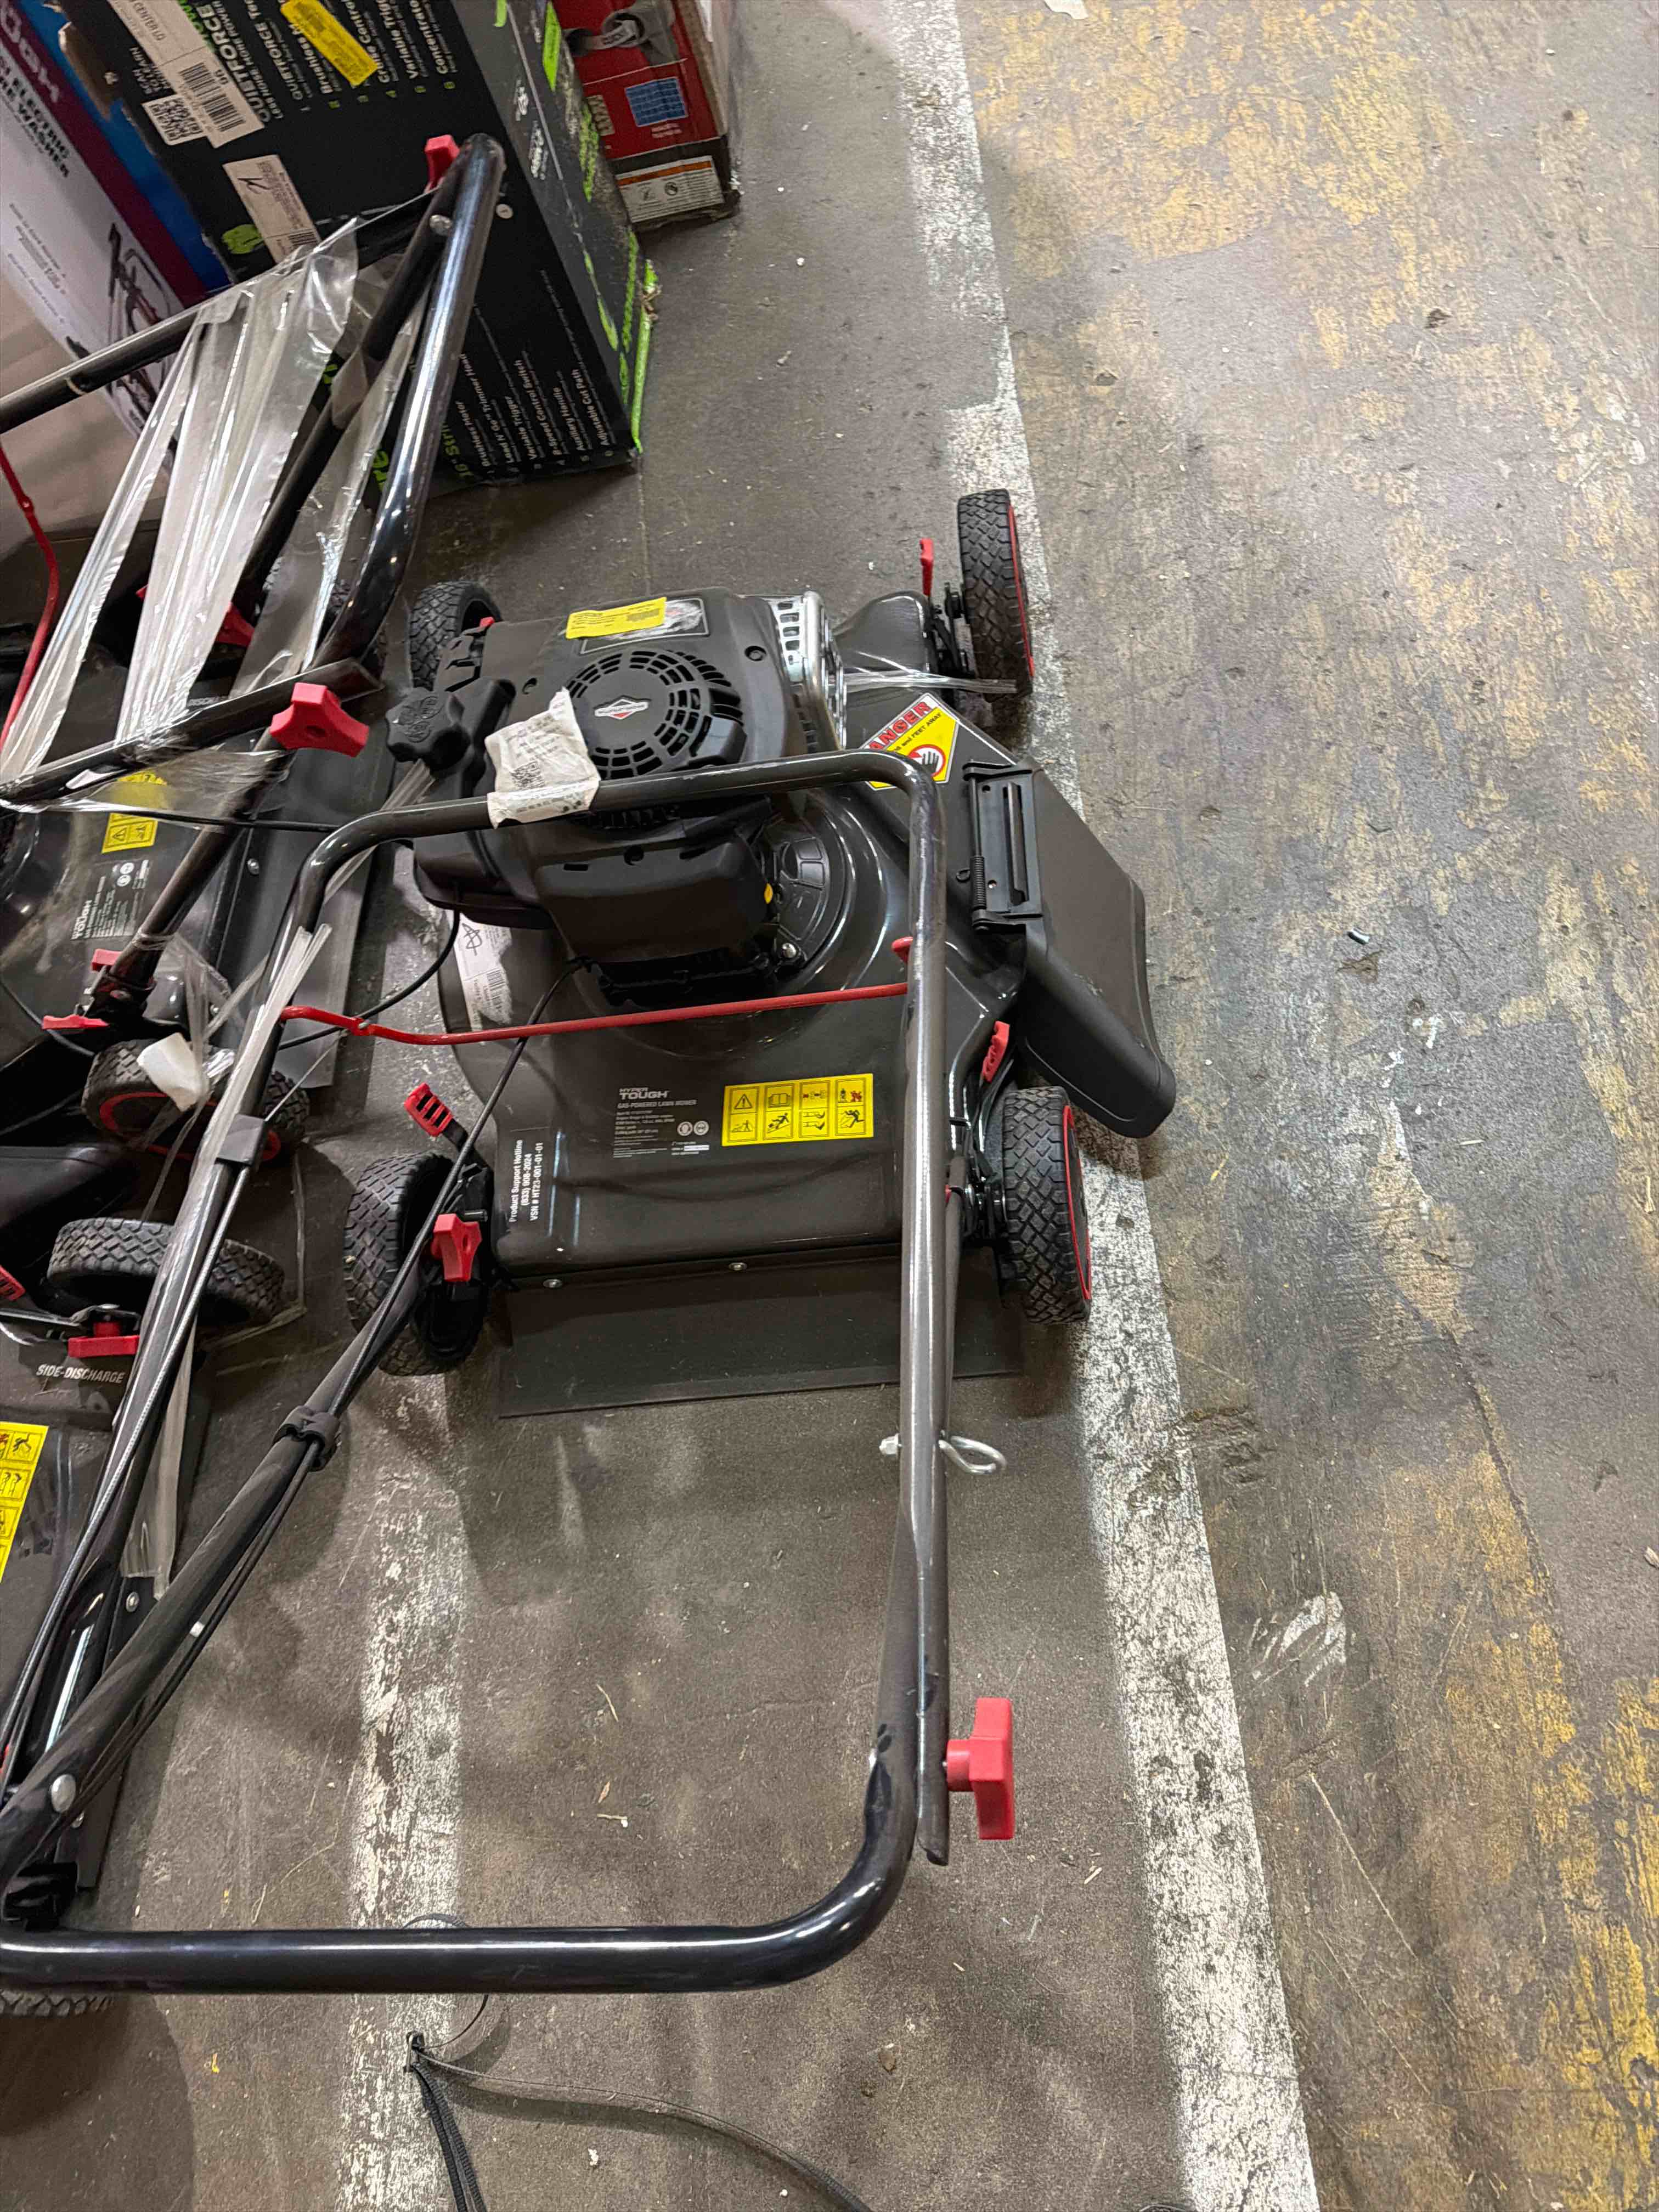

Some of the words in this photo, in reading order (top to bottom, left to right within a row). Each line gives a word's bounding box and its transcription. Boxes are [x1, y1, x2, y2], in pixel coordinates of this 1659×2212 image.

[196, 3, 273, 125] QUIETFORCE
[253, 21, 304, 101] QUIETFORCE
[296, 36, 334, 95] Brushless
[389, 28, 419, 80] Variable
[569, 368, 585, 390] Path
[469, 377, 492, 413] Trimmer
[526, 389, 546, 421] Control
[551, 386, 570, 417] Handle
[578, 390, 592, 405] Cut
[455, 400, 474, 426] Motor
[504, 396, 522, 426] Trigger
[586, 405, 609, 447] Adjustable
[517, 427, 537, 459] Variable
[868, 702, 932, 749] ANGER
[911, 725, 926, 738] FEET
[926, 712, 941, 727] AWAY
[619, 1091, 668, 1100] TOUGH
[514, 1139, 523, 1164] Hotline
[511, 1165, 522, 1193] Support
[509, 1194, 519, 1222] Product
[530, 1205, 539, 1221] VSN
[36, 1363, 126, 1383] SIDE-DISCHARGE
